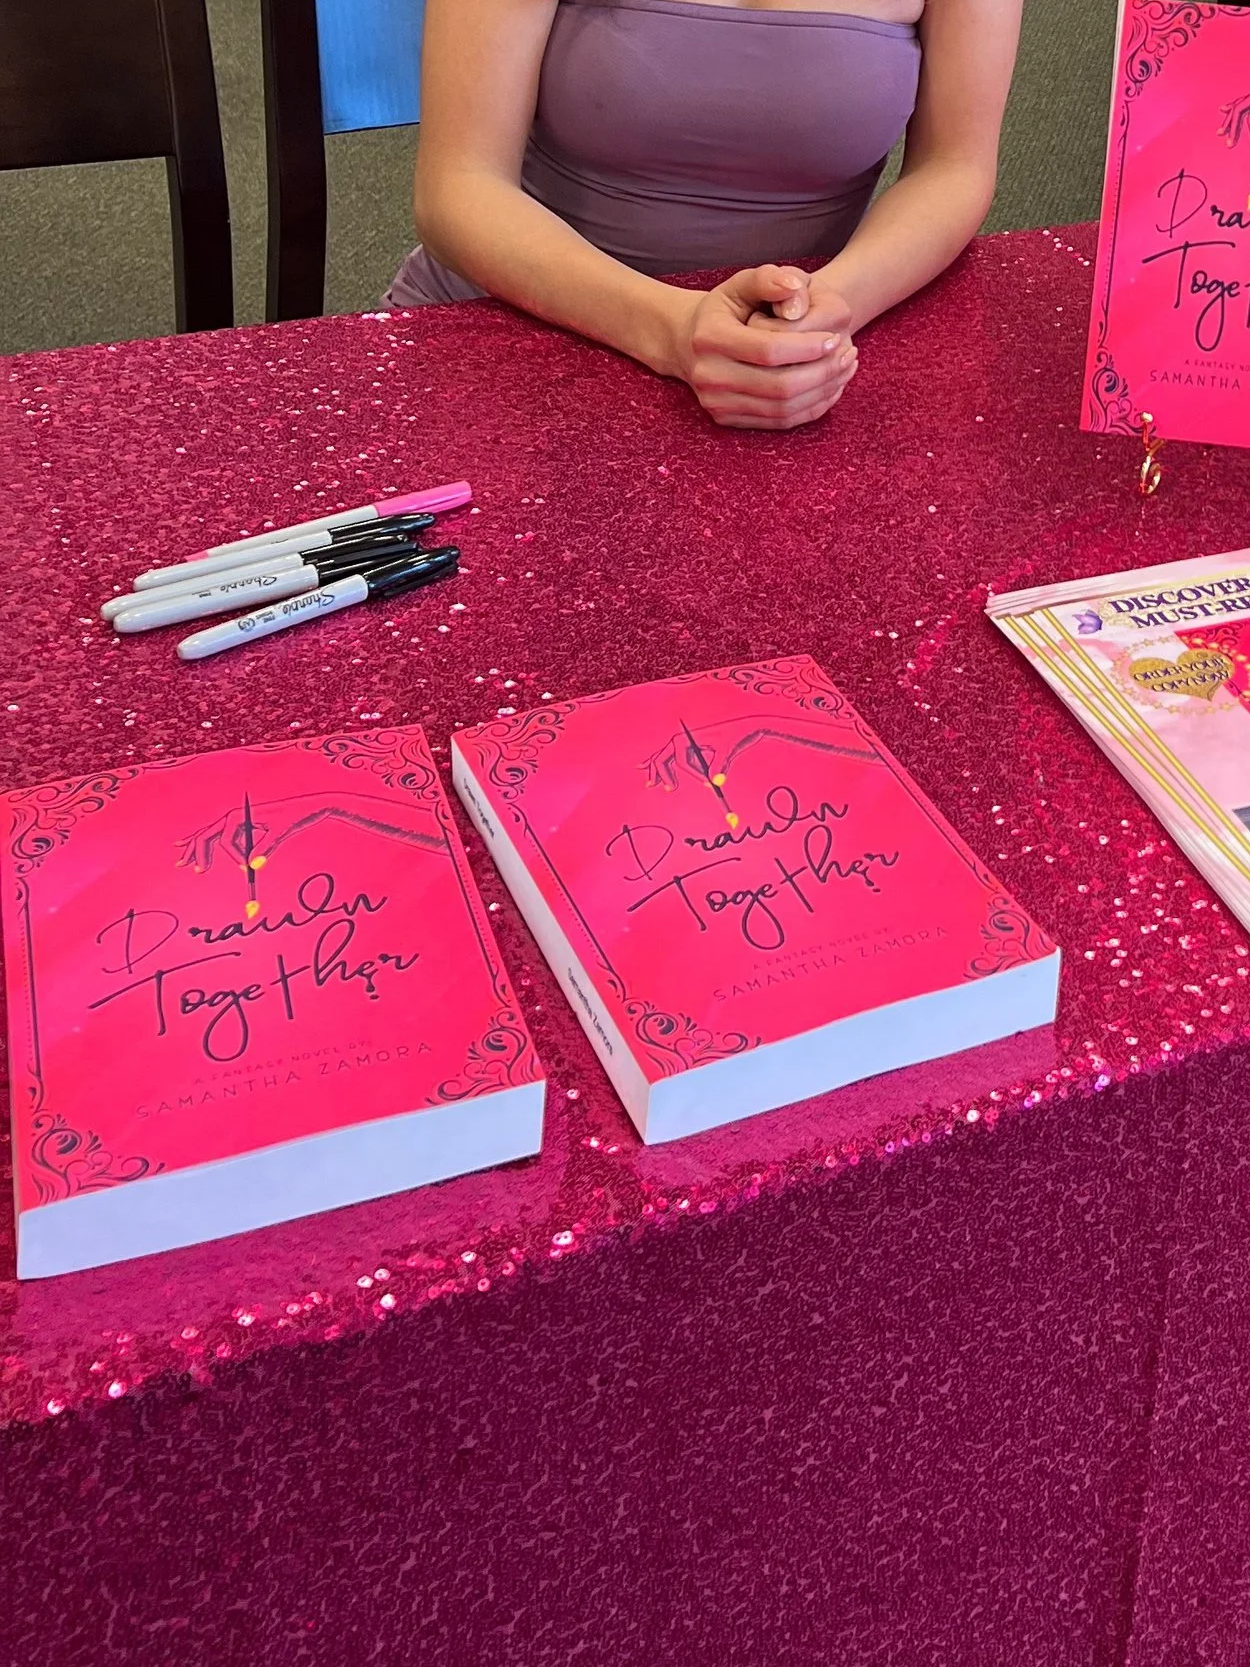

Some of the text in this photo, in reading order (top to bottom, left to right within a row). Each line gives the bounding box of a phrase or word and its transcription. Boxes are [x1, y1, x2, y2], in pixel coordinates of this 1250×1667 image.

[1149, 372, 1242, 393] SAMANTHA
[282, 586, 336, 617] Sharpie
[1133, 661, 1185, 683] ORDER
[604, 785, 850, 883] Drawn
[95, 871, 390, 975] Drawn
[626, 825, 900, 952] Together
[87, 918, 421, 1063] Together
[712, 925, 951, 1003] SAMANTHA ZAMORA
[135, 1041, 434, 1122] SAMANTHA ZAMORA
